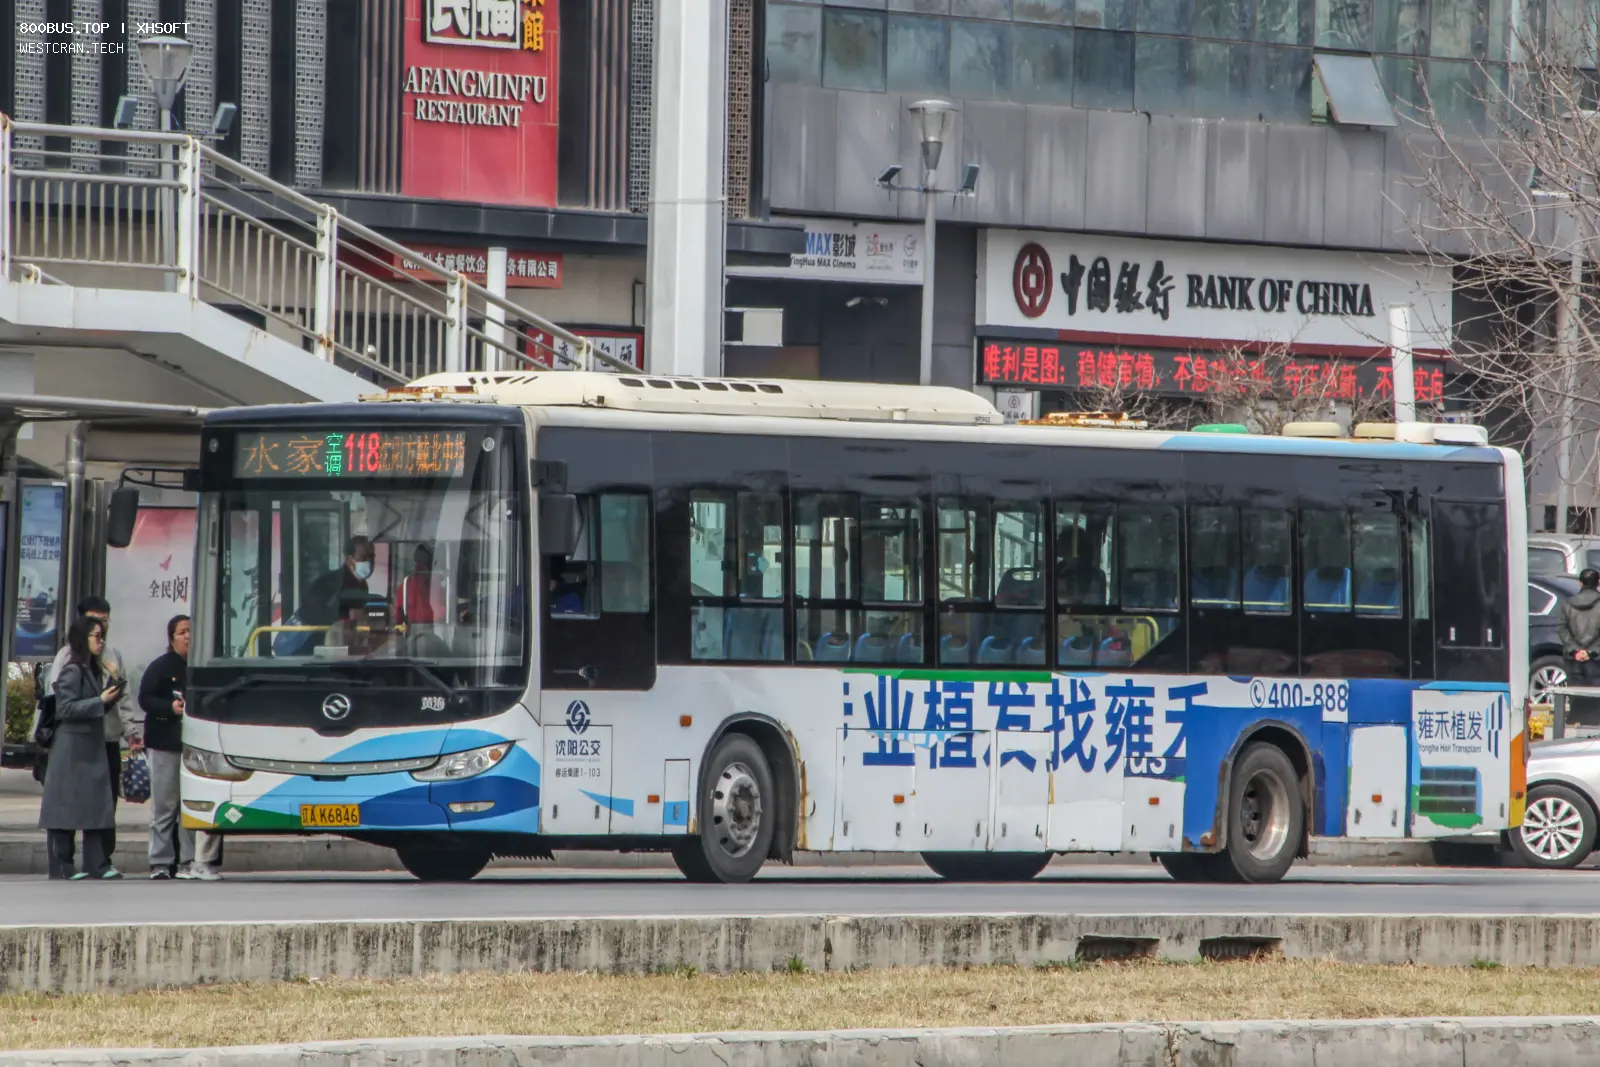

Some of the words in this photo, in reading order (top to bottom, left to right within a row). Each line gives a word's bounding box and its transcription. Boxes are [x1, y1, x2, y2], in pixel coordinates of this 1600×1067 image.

[404, 65, 547, 103] AFANGMINFU
[416, 98, 523, 127] RESTAURANT
[817, 258, 831, 268] MAX
[832, 260, 857, 270] Cinema
[1061, 254, 1176, 321] 中国银行
[1186, 273, 1255, 311] BANK
[1258, 278, 1293, 313] OF
[1295, 280, 1376, 316] CHINA
[325, 433, 343, 476] 空调
[345, 432, 380, 472] 118
[421, 696, 445, 711] 黄海
[1268, 682, 1348, 712] 400-888
[843, 675, 1208, 773] 业植发找雍禾
[1418, 710, 1483, 740] 雍禾植发
[555, 739, 601, 756] 沈阳公交
[1440, 744, 1451, 753] Hair
[1452, 744, 1482, 755] Transplant
[319, 807, 358, 824] K6846
